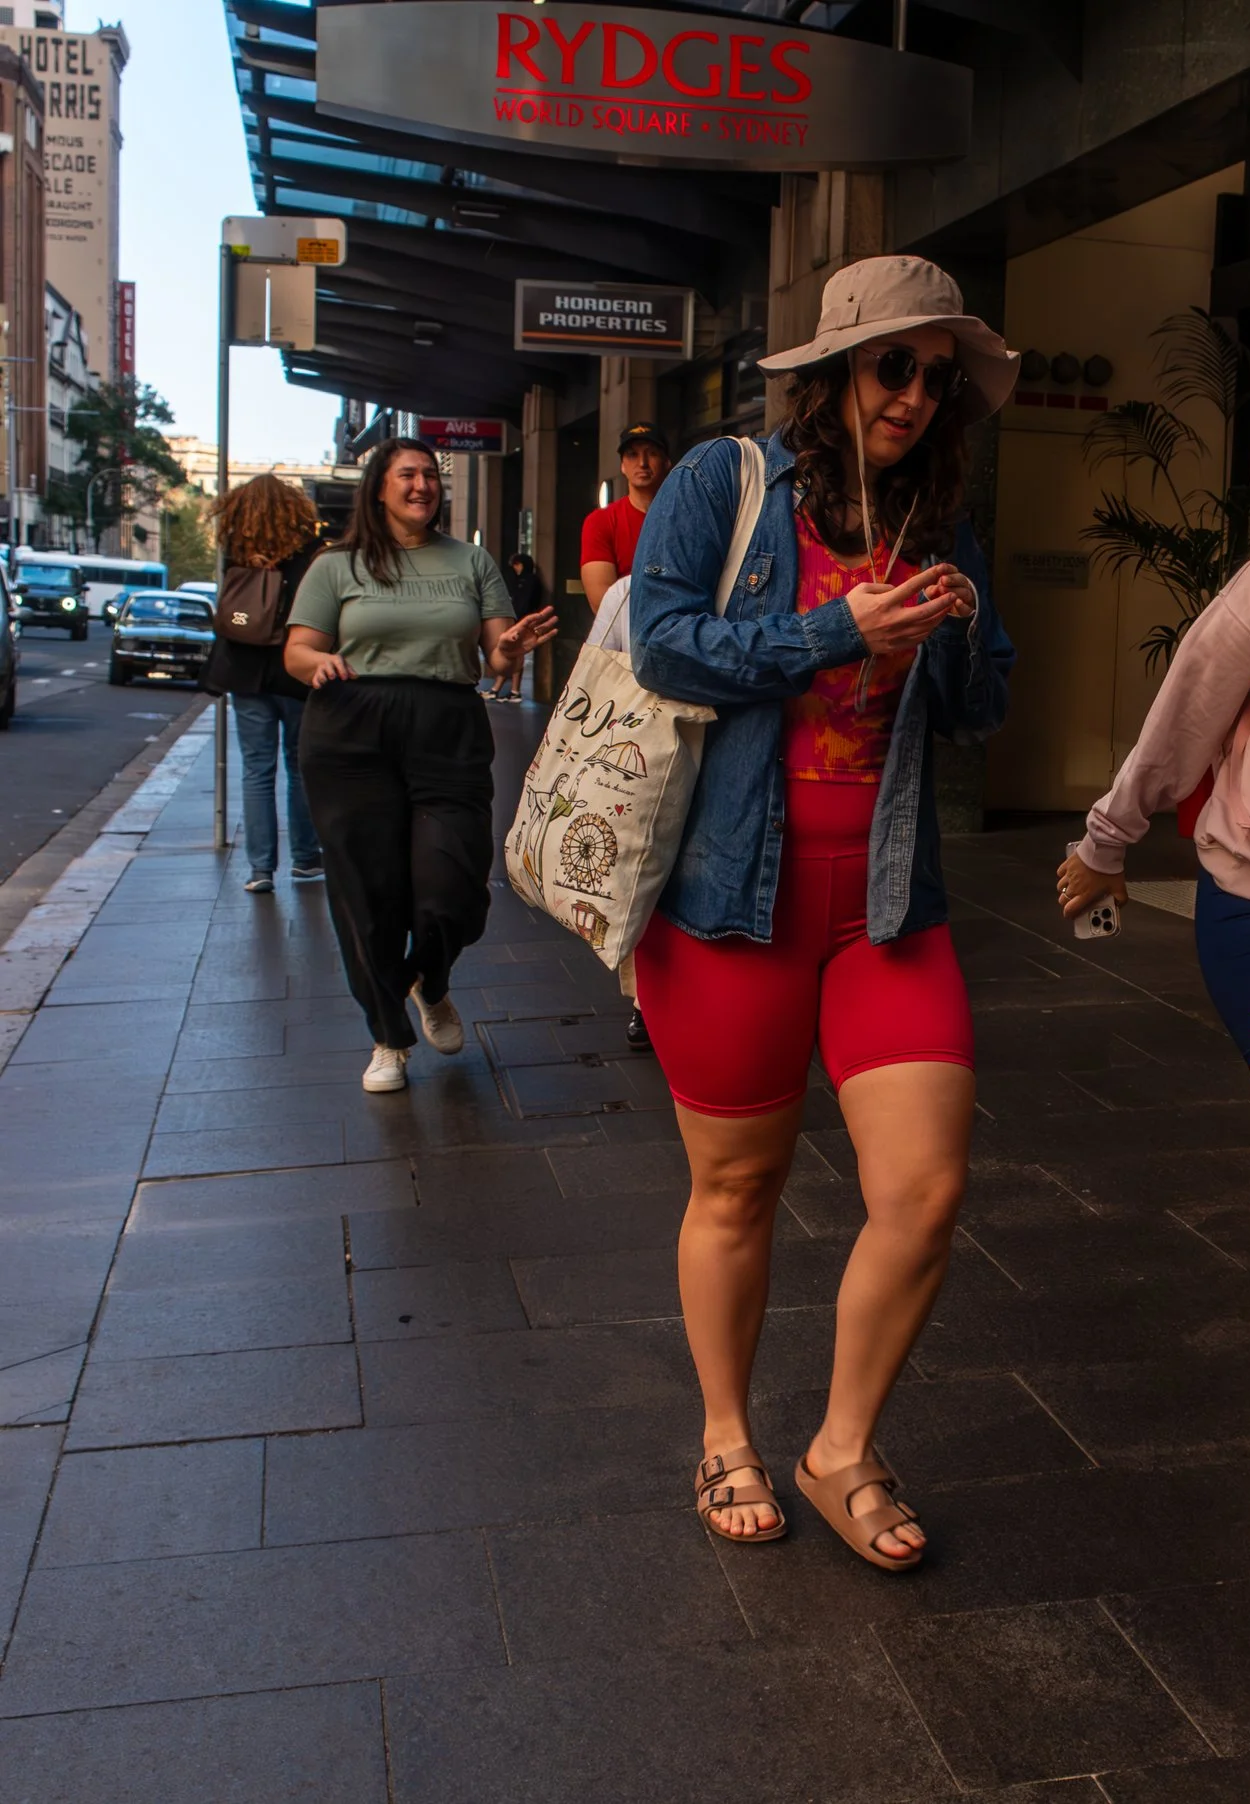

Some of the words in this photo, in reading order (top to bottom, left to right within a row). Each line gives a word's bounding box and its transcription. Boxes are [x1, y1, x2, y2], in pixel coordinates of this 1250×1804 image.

[20, 35, 94, 76] HOTEL
[495, 12, 813, 104] RYDGES
[493, 96, 584, 128] WORLD
[592, 105, 692, 137] SQUARE
[718, 117, 809, 147] SYDNEY
[555, 295, 653, 315] HORDERN
[539, 312, 668, 333] PROPERTIES
[445, 421, 477, 434] AVIS
